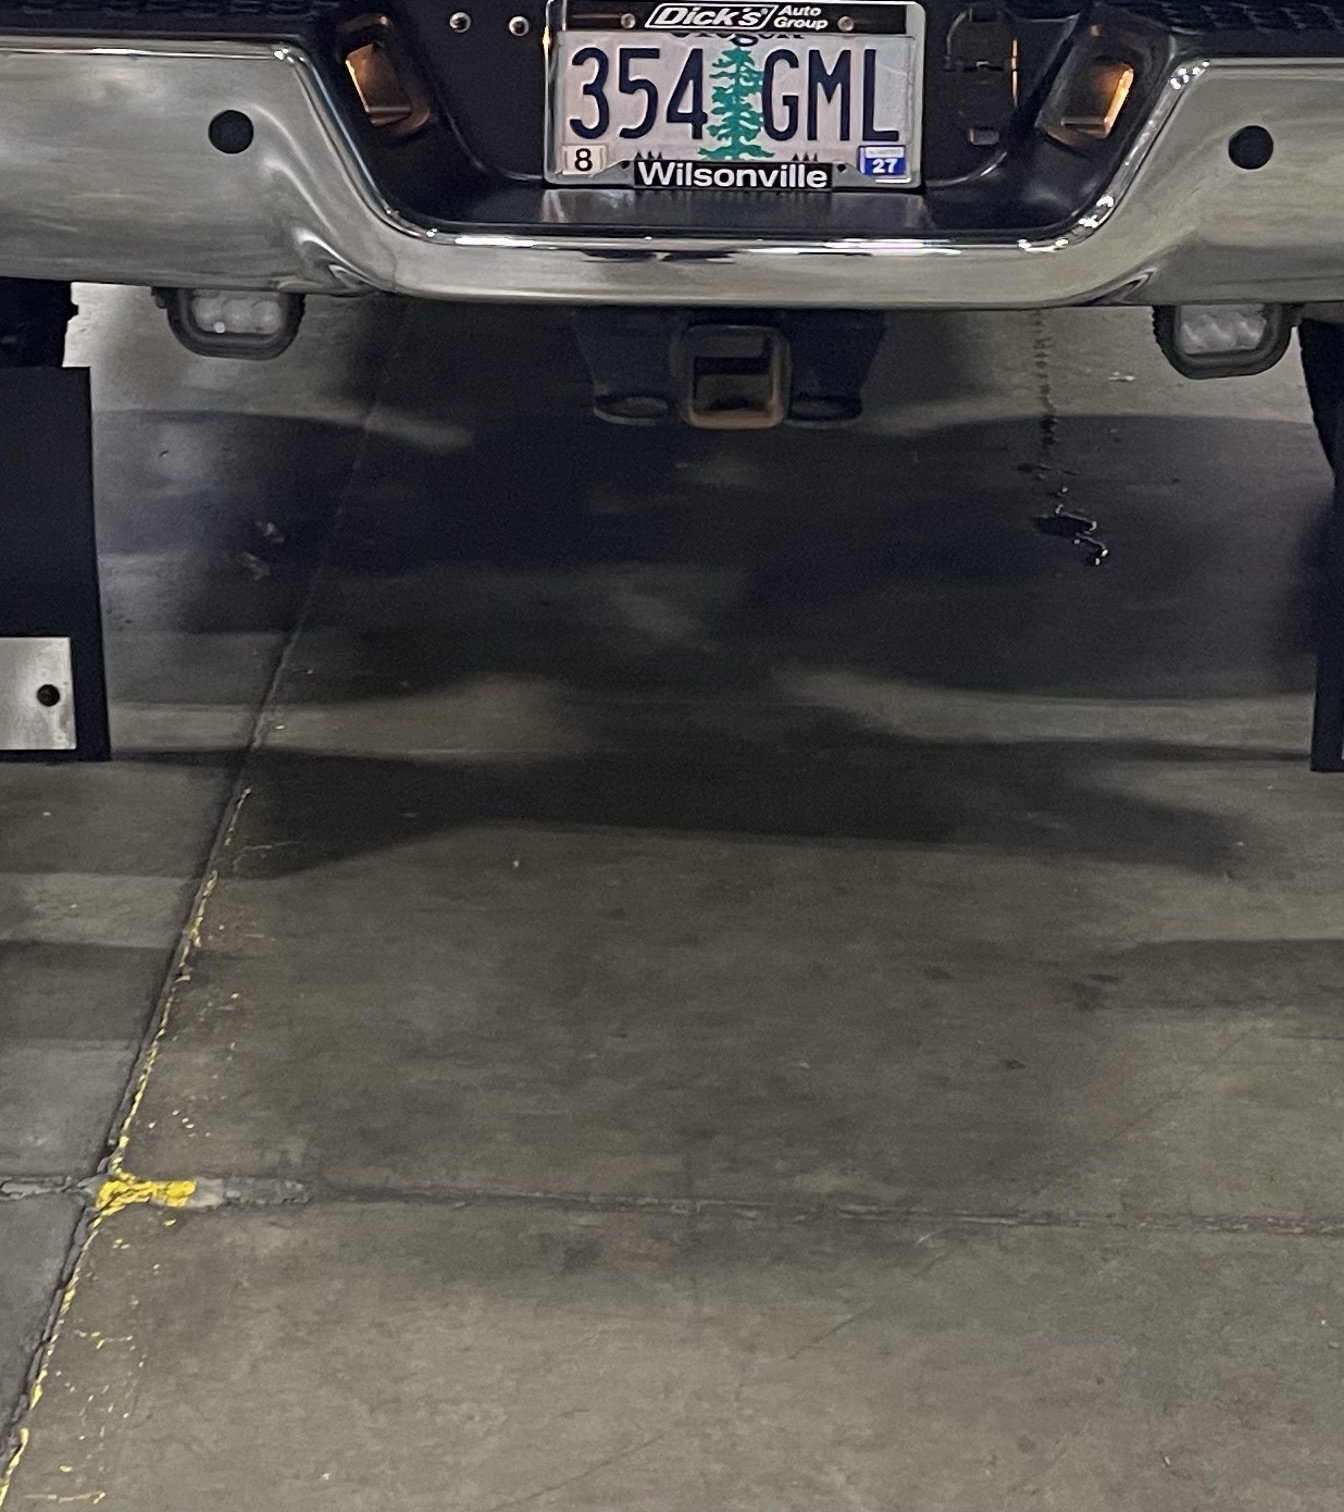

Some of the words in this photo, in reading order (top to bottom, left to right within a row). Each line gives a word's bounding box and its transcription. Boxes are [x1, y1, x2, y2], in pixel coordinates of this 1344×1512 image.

[653, 5, 762, 27] Dick's
[778, 5, 821, 18] Auto
[773, 17, 828, 30] Group
[569, 46, 708, 140] 354
[761, 48, 899, 142] GML
[575, 148, 593, 172] 8
[872, 158, 899, 174] 27
[638, 161, 828, 188] Wilsonville
